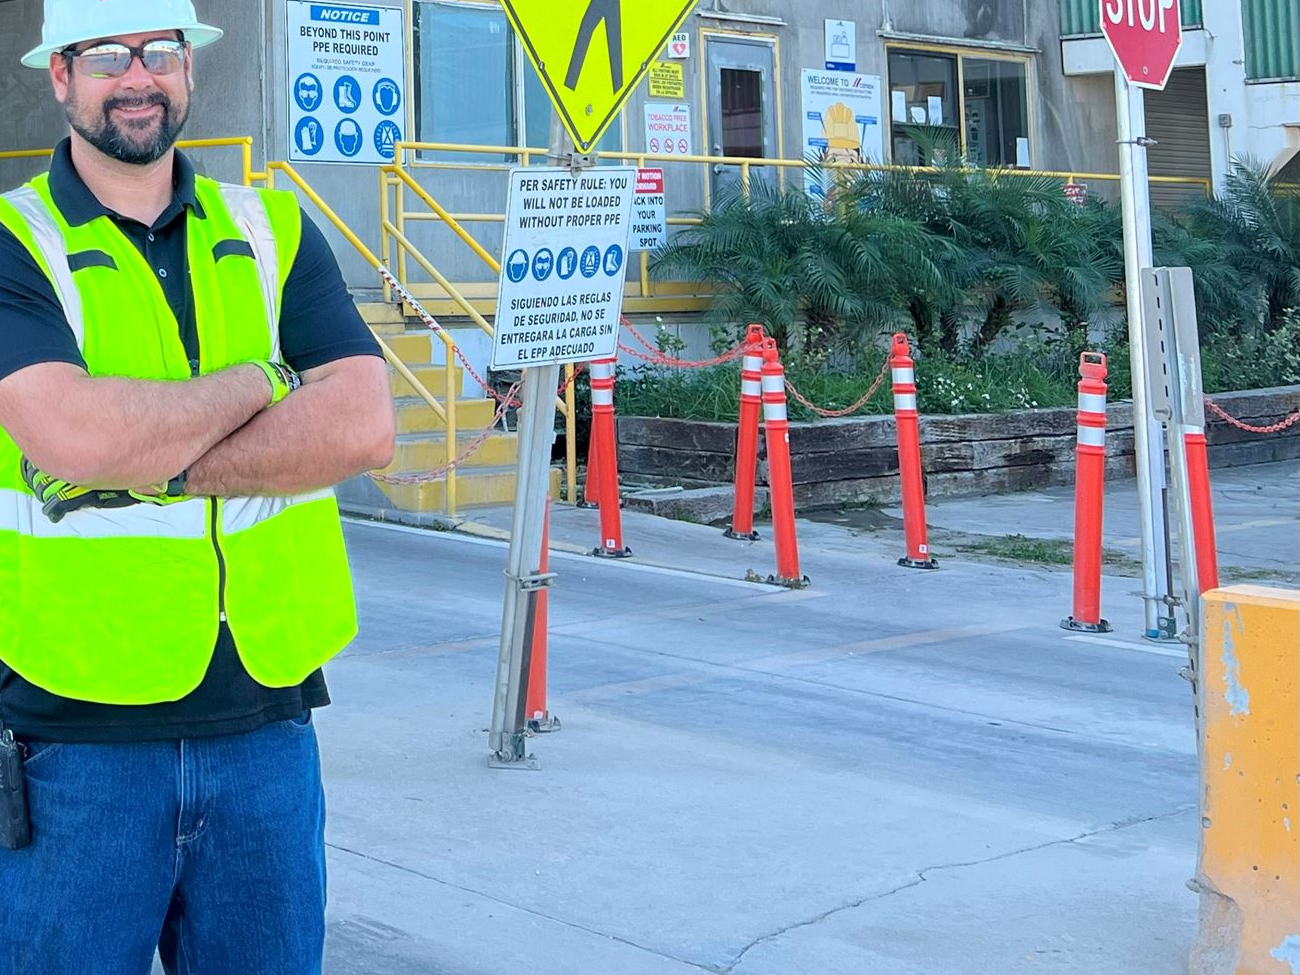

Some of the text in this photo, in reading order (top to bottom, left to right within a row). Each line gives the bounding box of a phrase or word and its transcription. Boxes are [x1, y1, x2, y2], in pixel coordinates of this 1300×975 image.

[320, 9, 370, 22] NOTICE
[300, 26, 390, 42] BEYOND THIS POINT
[313, 42, 378, 55] PPE REQUIRED
[808, 76, 839, 86] WELCOME
[840, 79, 849, 87] TO
[648, 123, 688, 132] WORKPLACE
[520, 178, 627, 192] PER SAFETY RULE: YOU
[523, 196, 621, 209] WILL NOT BE LOADED
[648, 197, 663, 205] INTO
[519, 213, 621, 228] WITHOUT PROPER PPE
[637, 211, 656, 219] YOUR
[633, 224, 662, 233] PARKING
[640, 238, 657, 247] SPOT
[511, 292, 611, 310] SIGUIENDO LAS REGLAS
[514, 309, 605, 327] DE SEGURIDAD, NO SE
[501, 324, 613, 345] ENTREGARA LA CARGA SIN
[518, 342, 594, 360] EL EPP ADECUADO
